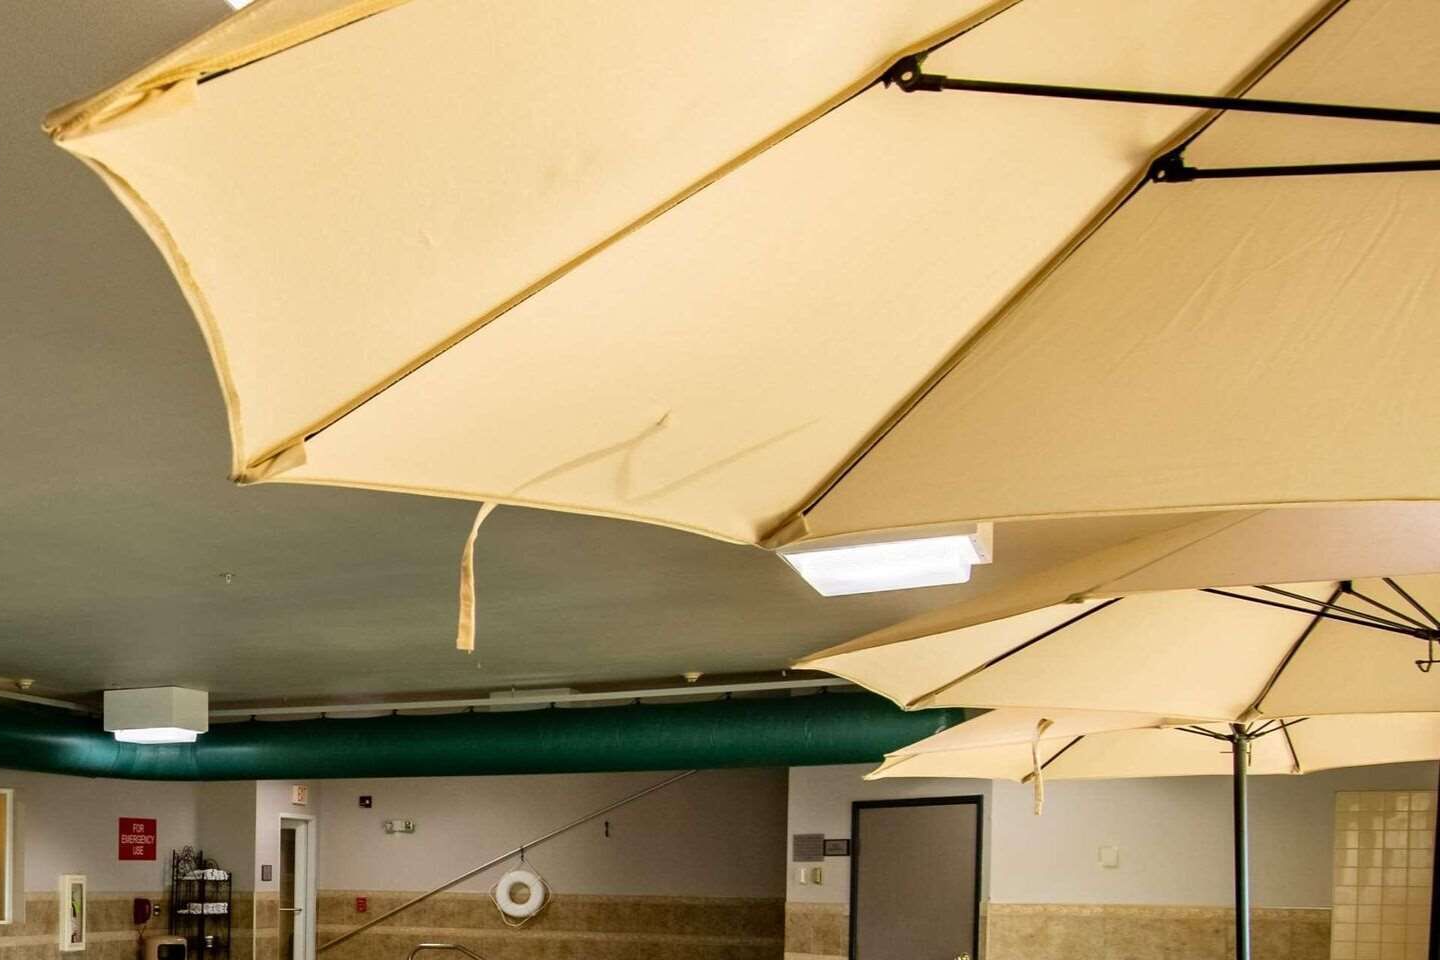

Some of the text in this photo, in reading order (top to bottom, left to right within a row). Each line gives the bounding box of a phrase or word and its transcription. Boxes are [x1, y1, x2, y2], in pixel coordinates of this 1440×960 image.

[132, 823, 145, 833] FOR
[121, 834, 155, 845] EMERGENCY
[132, 845, 144, 856] USE
